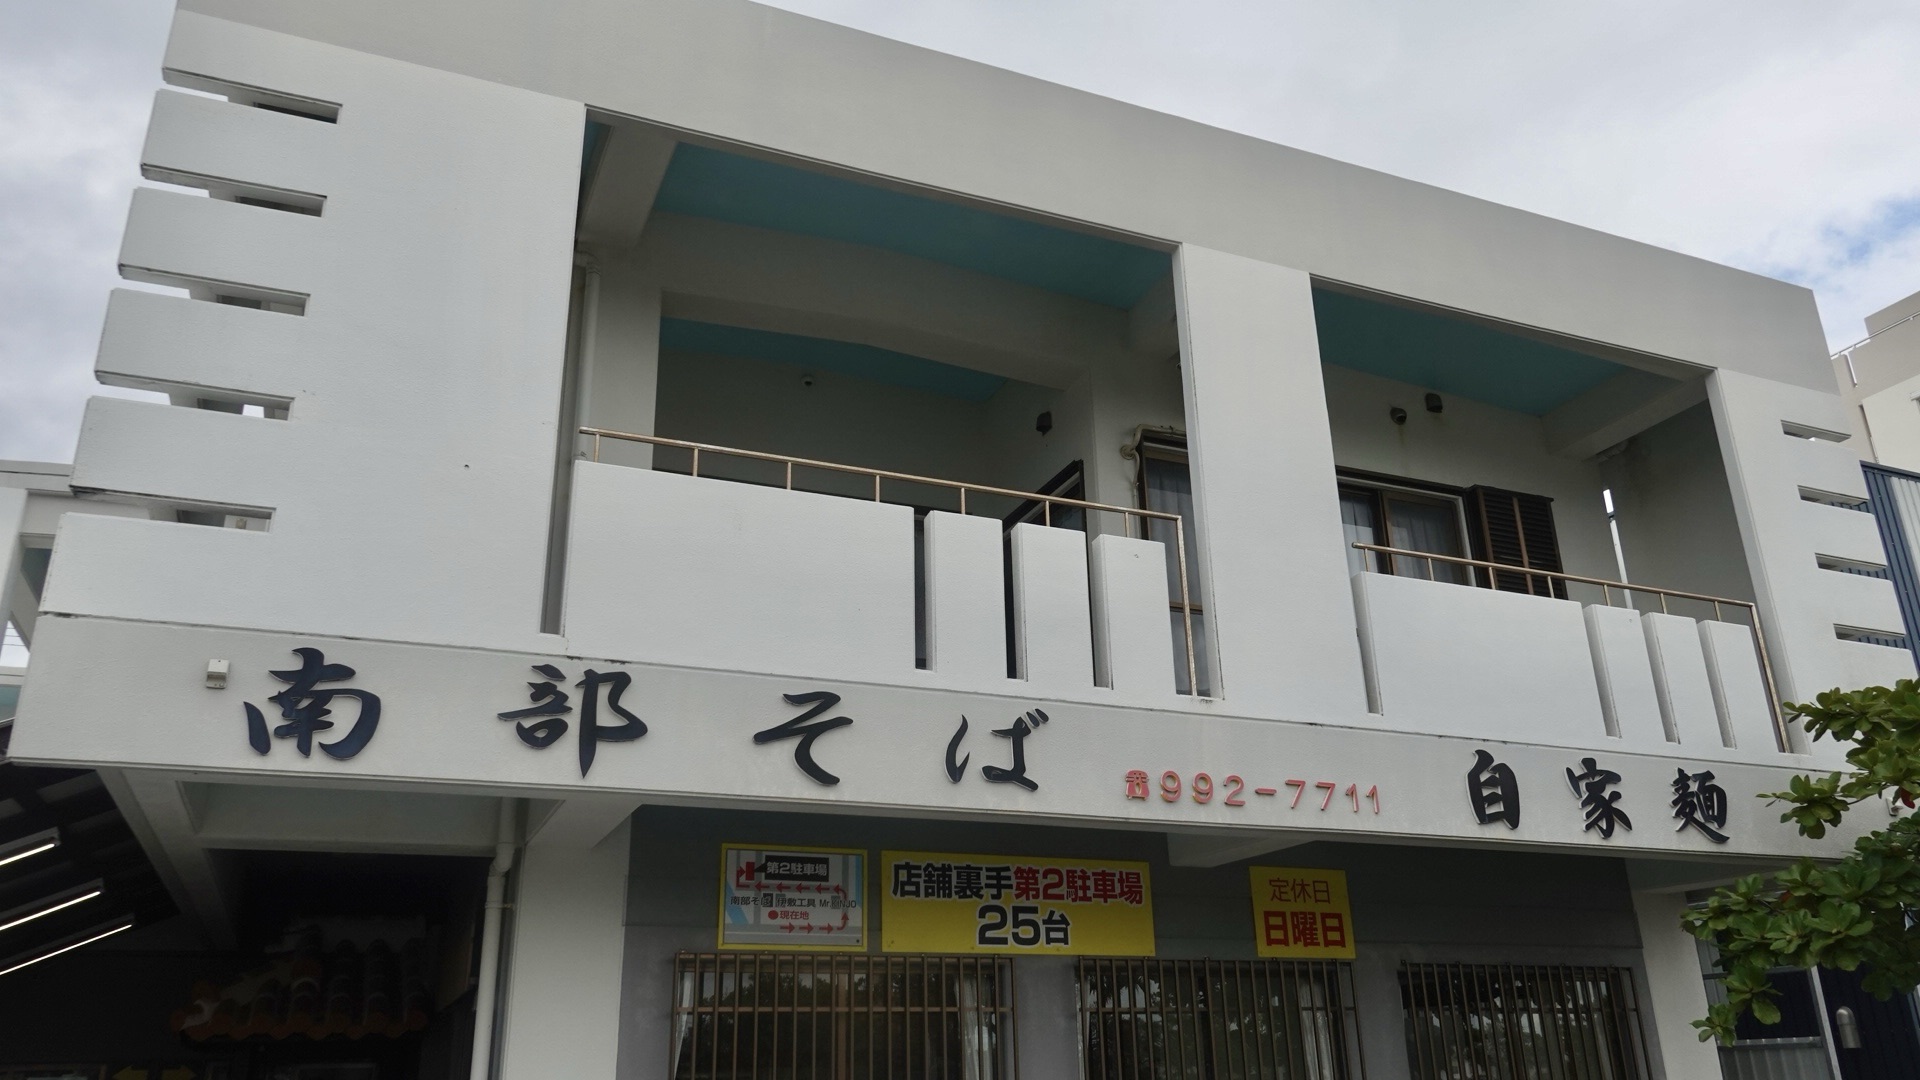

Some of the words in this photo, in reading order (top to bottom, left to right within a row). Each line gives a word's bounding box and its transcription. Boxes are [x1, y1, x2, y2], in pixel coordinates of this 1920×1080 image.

[243, 647, 1050, 793] 南部そば
[1160, 770, 1381, 815] 992-7711
[1465, 748, 1731, 845] 自家麺
[766, 861, 828, 877] 第2駐車場
[892, 861, 1145, 905] 店舗裏手第2駐車場
[1268, 878, 1331, 905] 定休日
[780, 910, 809, 920] 現在地
[976, 904, 1071, 947] 25台
[1263, 910, 1347, 949] 日曜日
